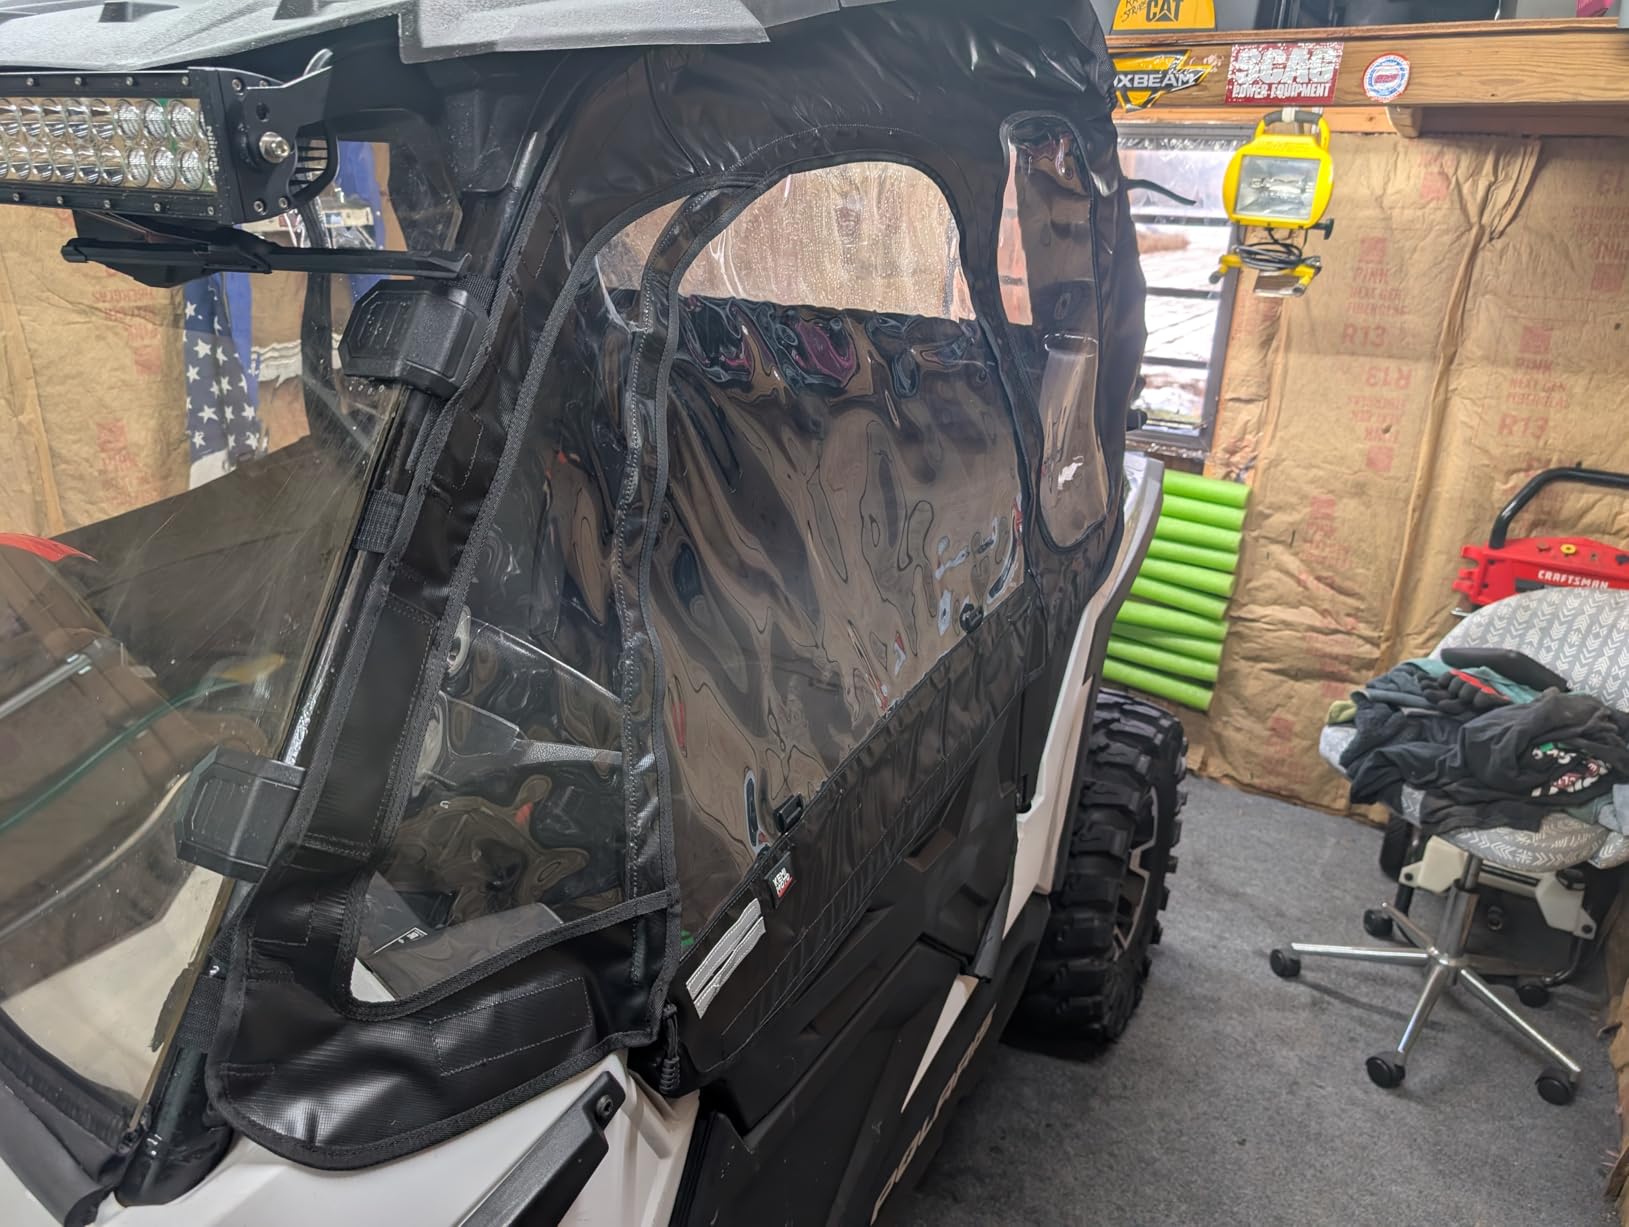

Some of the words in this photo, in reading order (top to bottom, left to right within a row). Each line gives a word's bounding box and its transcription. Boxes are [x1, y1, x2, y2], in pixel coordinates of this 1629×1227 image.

[1145, 0, 1184, 22] CAT
[1235, 48, 1336, 83] SCAG
[1232, 84, 1268, 98] POWER
[1270, 83, 1331, 98] EQUIPMENT
[1342, 323, 1387, 347] R13
[1366, 367, 1412, 390] R13
[1498, 413, 1549, 439] R13
[1538, 570, 1609, 589] CRAFTSMAN
